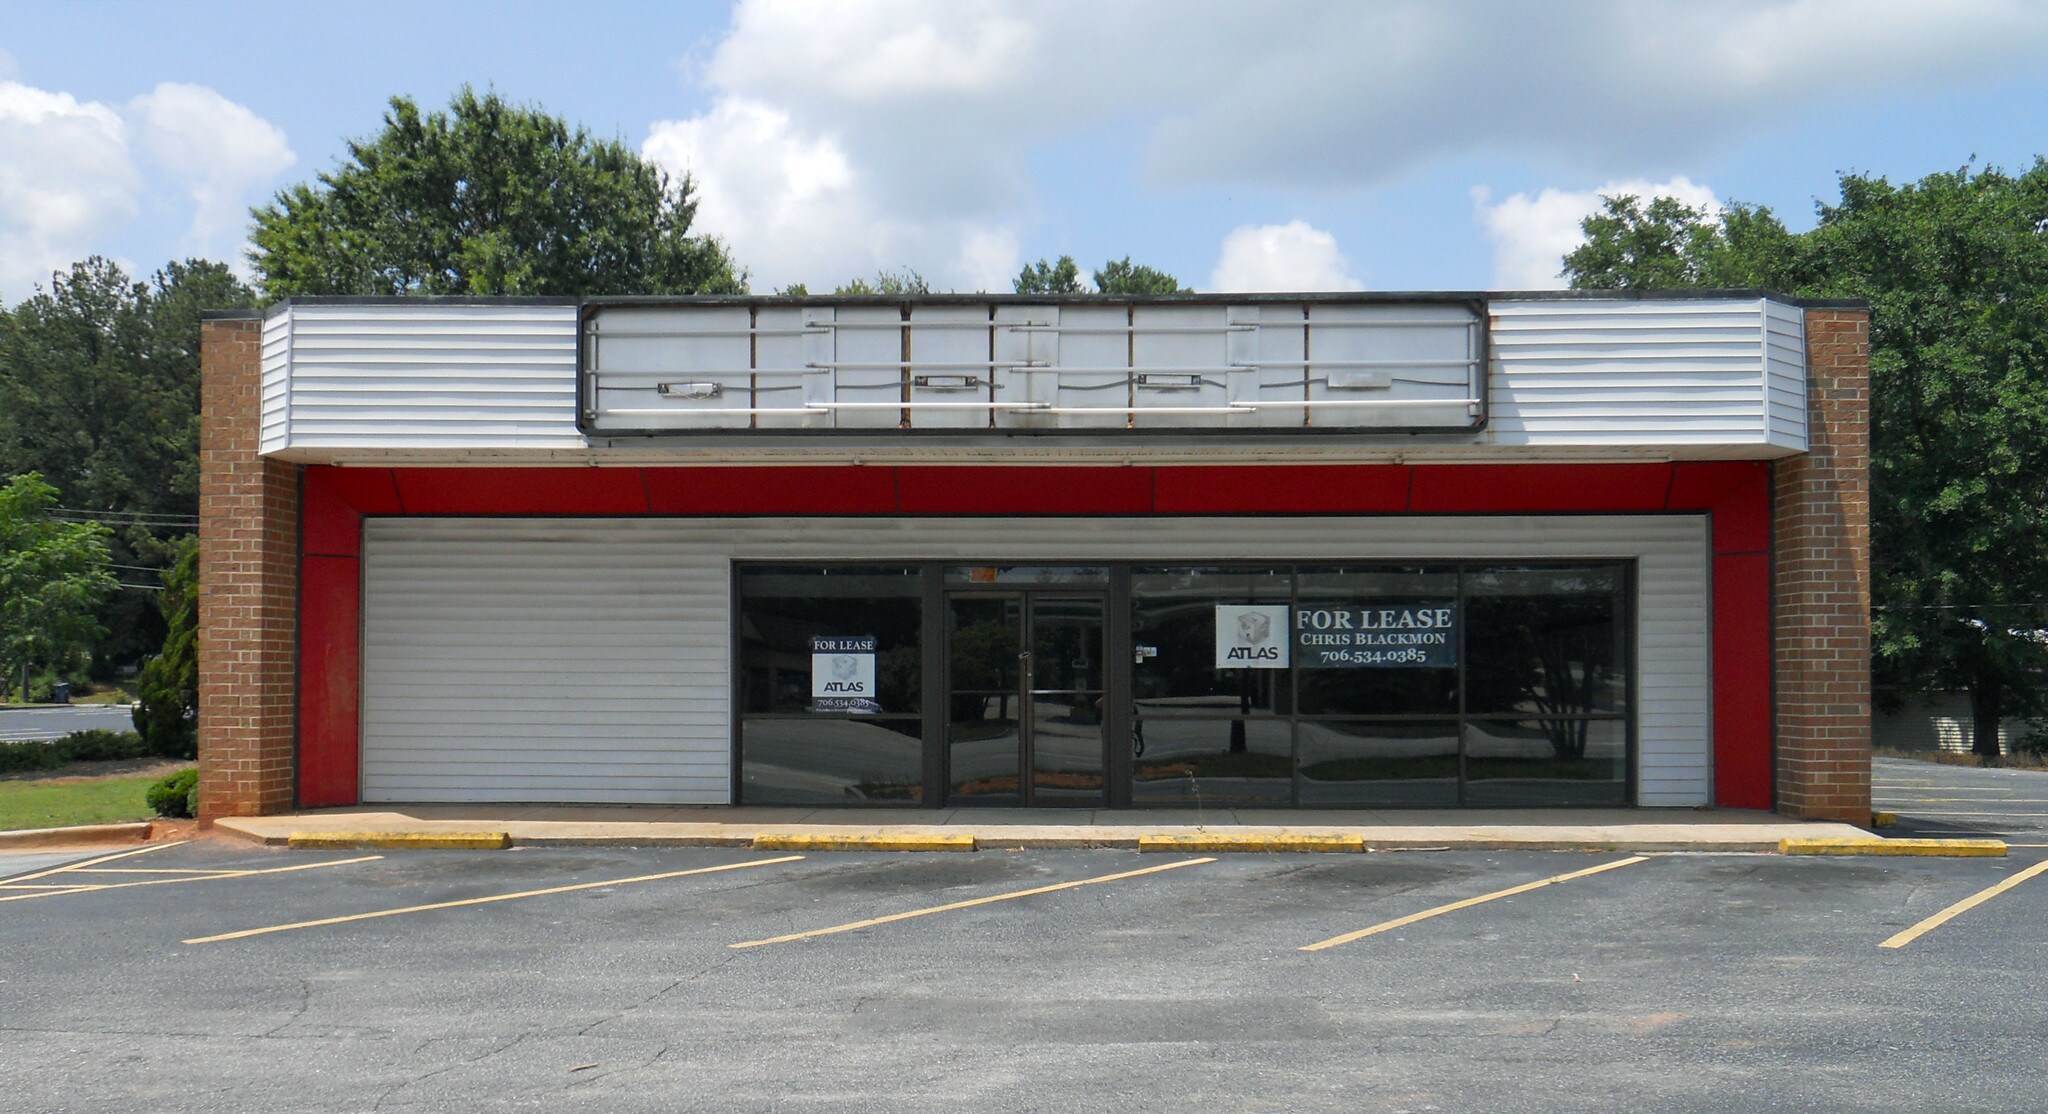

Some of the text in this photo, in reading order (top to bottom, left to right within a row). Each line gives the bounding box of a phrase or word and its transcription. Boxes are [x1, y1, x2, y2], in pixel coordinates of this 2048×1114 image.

[1297, 609, 1452, 630] FOR LEASE
[814, 640, 874, 650] FOR LEASE
[1300, 633, 1446, 646] CHRIS BLACKMON
[1227, 647, 1278, 660] ATLAS
[1320, 649, 1427, 664] 706.534.0385
[824, 682, 864, 692] ATLAS
[818, 698, 870, 708] 706.534.0385
